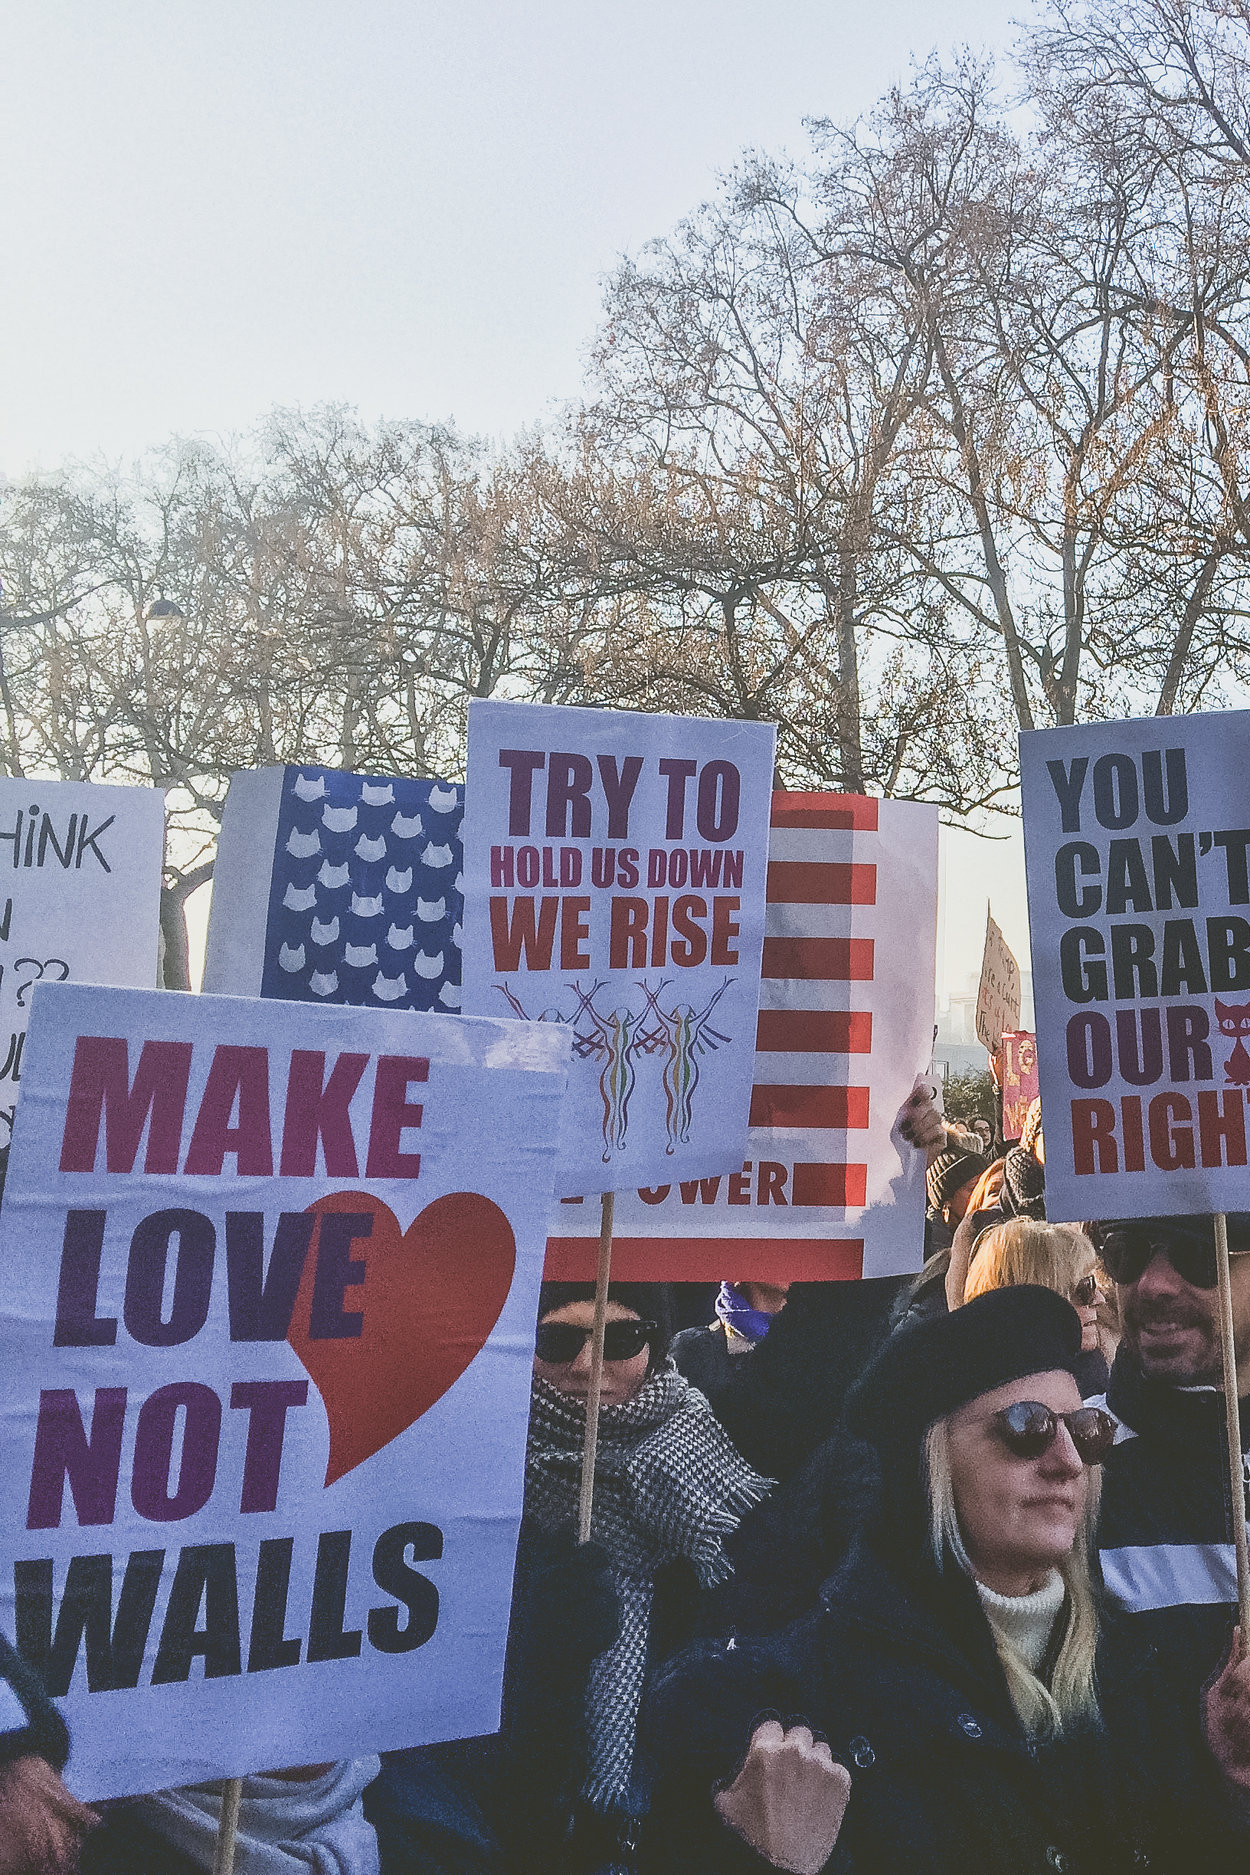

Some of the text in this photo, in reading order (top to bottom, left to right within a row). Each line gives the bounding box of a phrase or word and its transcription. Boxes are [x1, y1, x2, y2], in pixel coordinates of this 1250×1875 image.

[500, 749, 740, 842] TRY TO
[1046, 748, 1190, 833] YOU
[490, 846, 744, 889] HOLD US DOWN
[489, 895, 741, 972] WE RISE
[1066, 1005, 1214, 1089] OUR
[59, 1035, 430, 1179] MAKE
[54, 1209, 373, 1348] LOVE
[26, 1377, 308, 1530] NOT
[13, 1521, 443, 1698] WALLS
